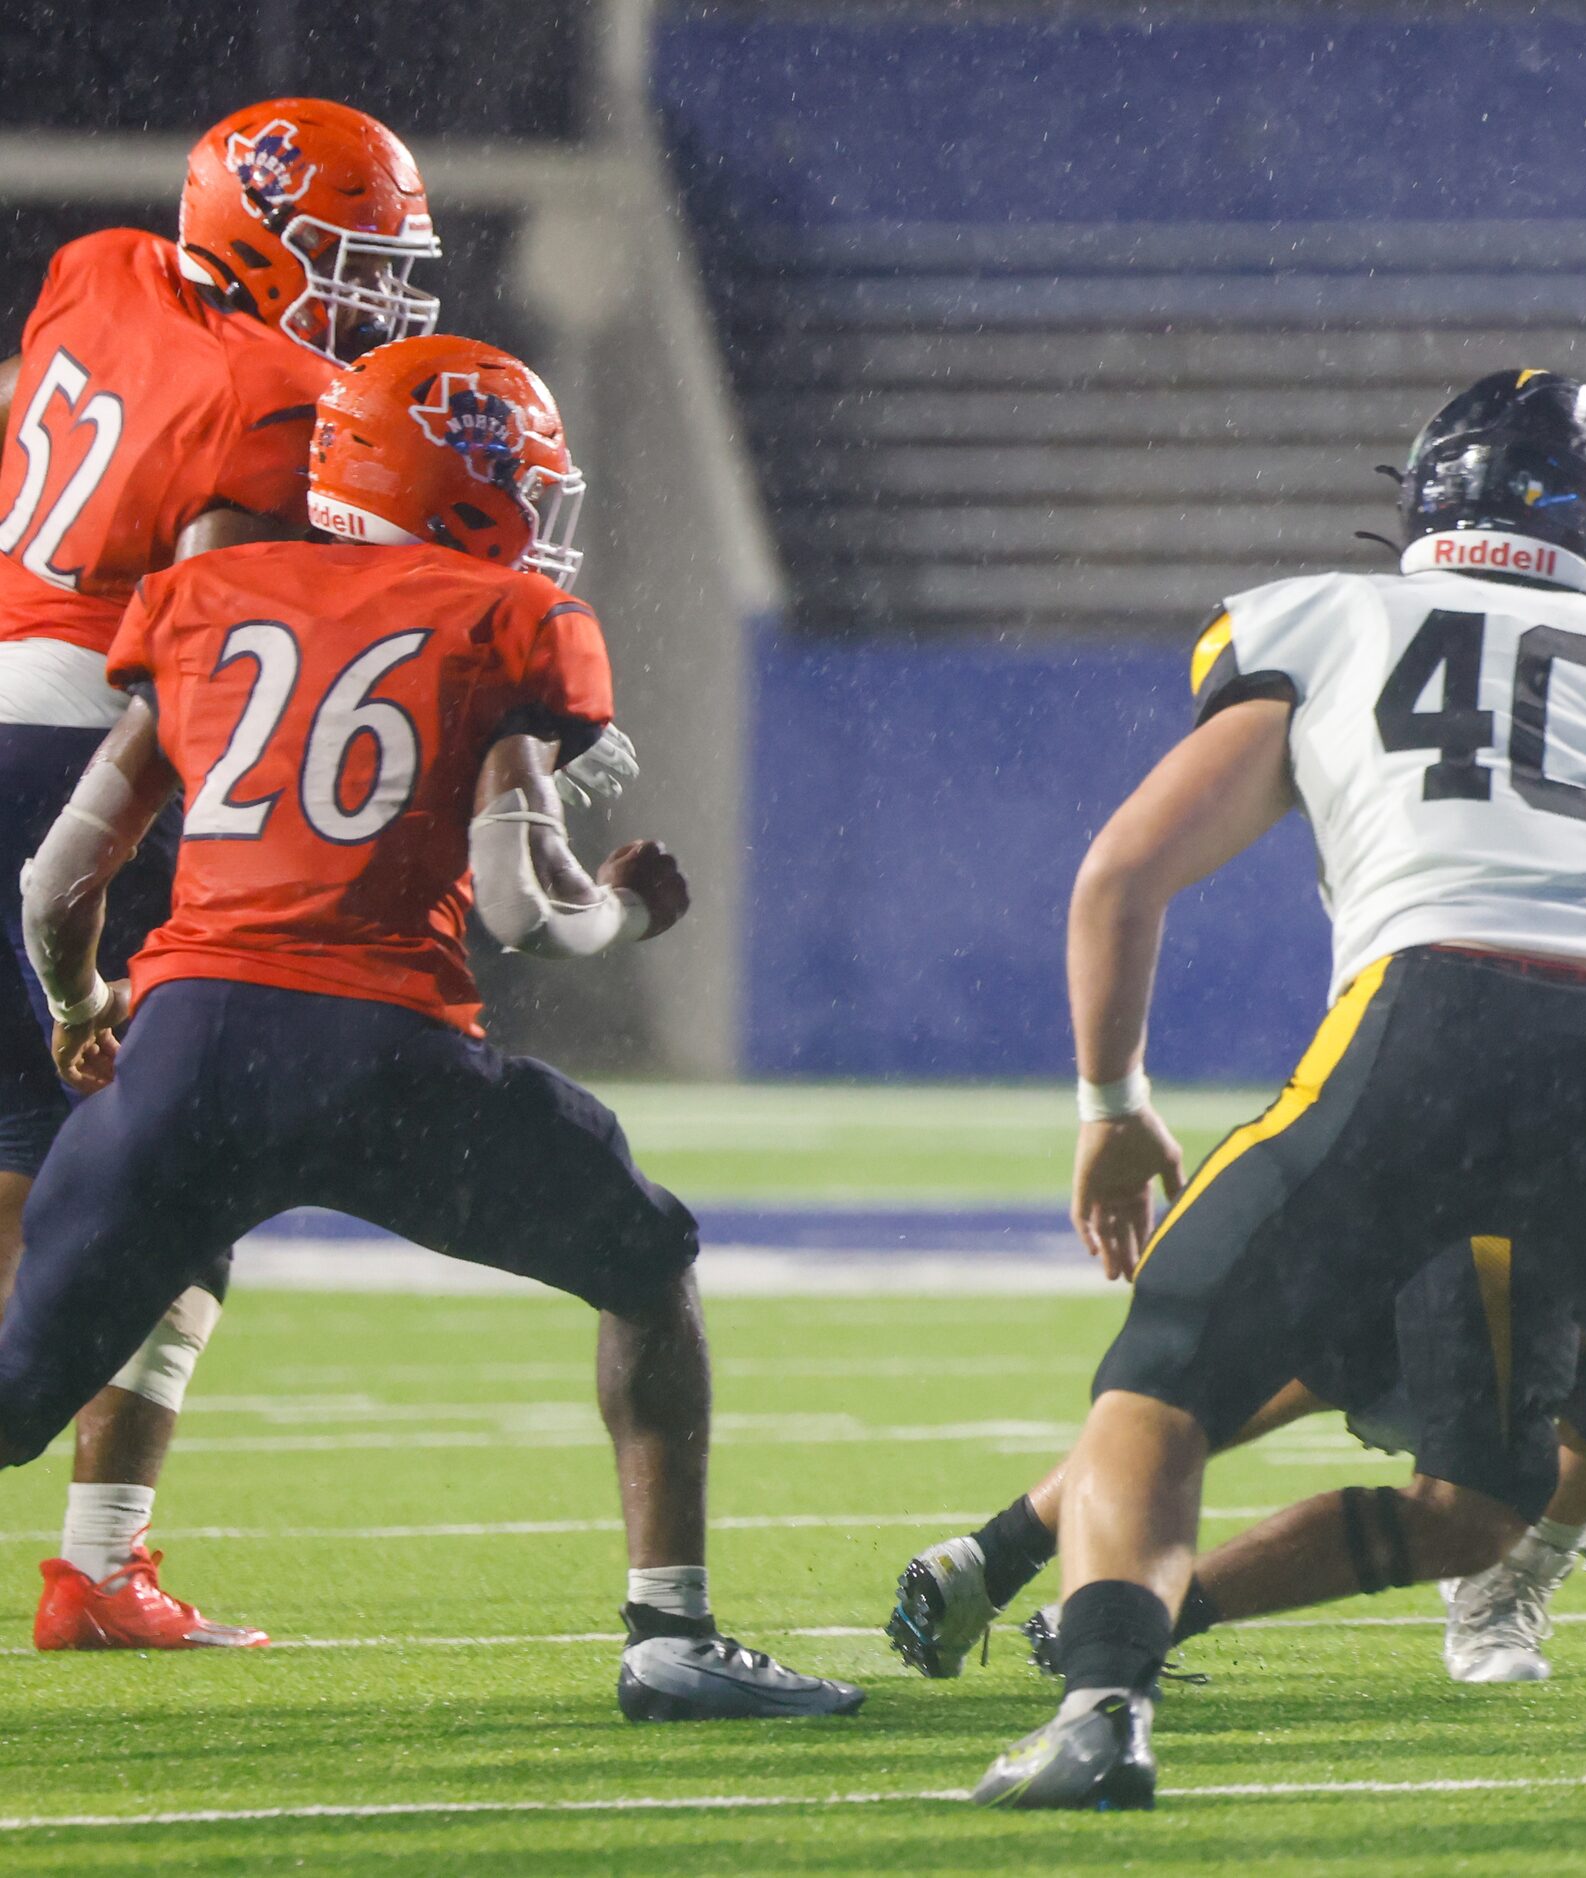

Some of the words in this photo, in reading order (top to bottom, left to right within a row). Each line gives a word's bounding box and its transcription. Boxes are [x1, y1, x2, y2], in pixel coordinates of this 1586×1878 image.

[0, 345, 124, 594] 52
[446, 413, 510, 442] NORTH
[1433, 539, 1557, 577] Riddell
[181, 619, 435, 847] 26
